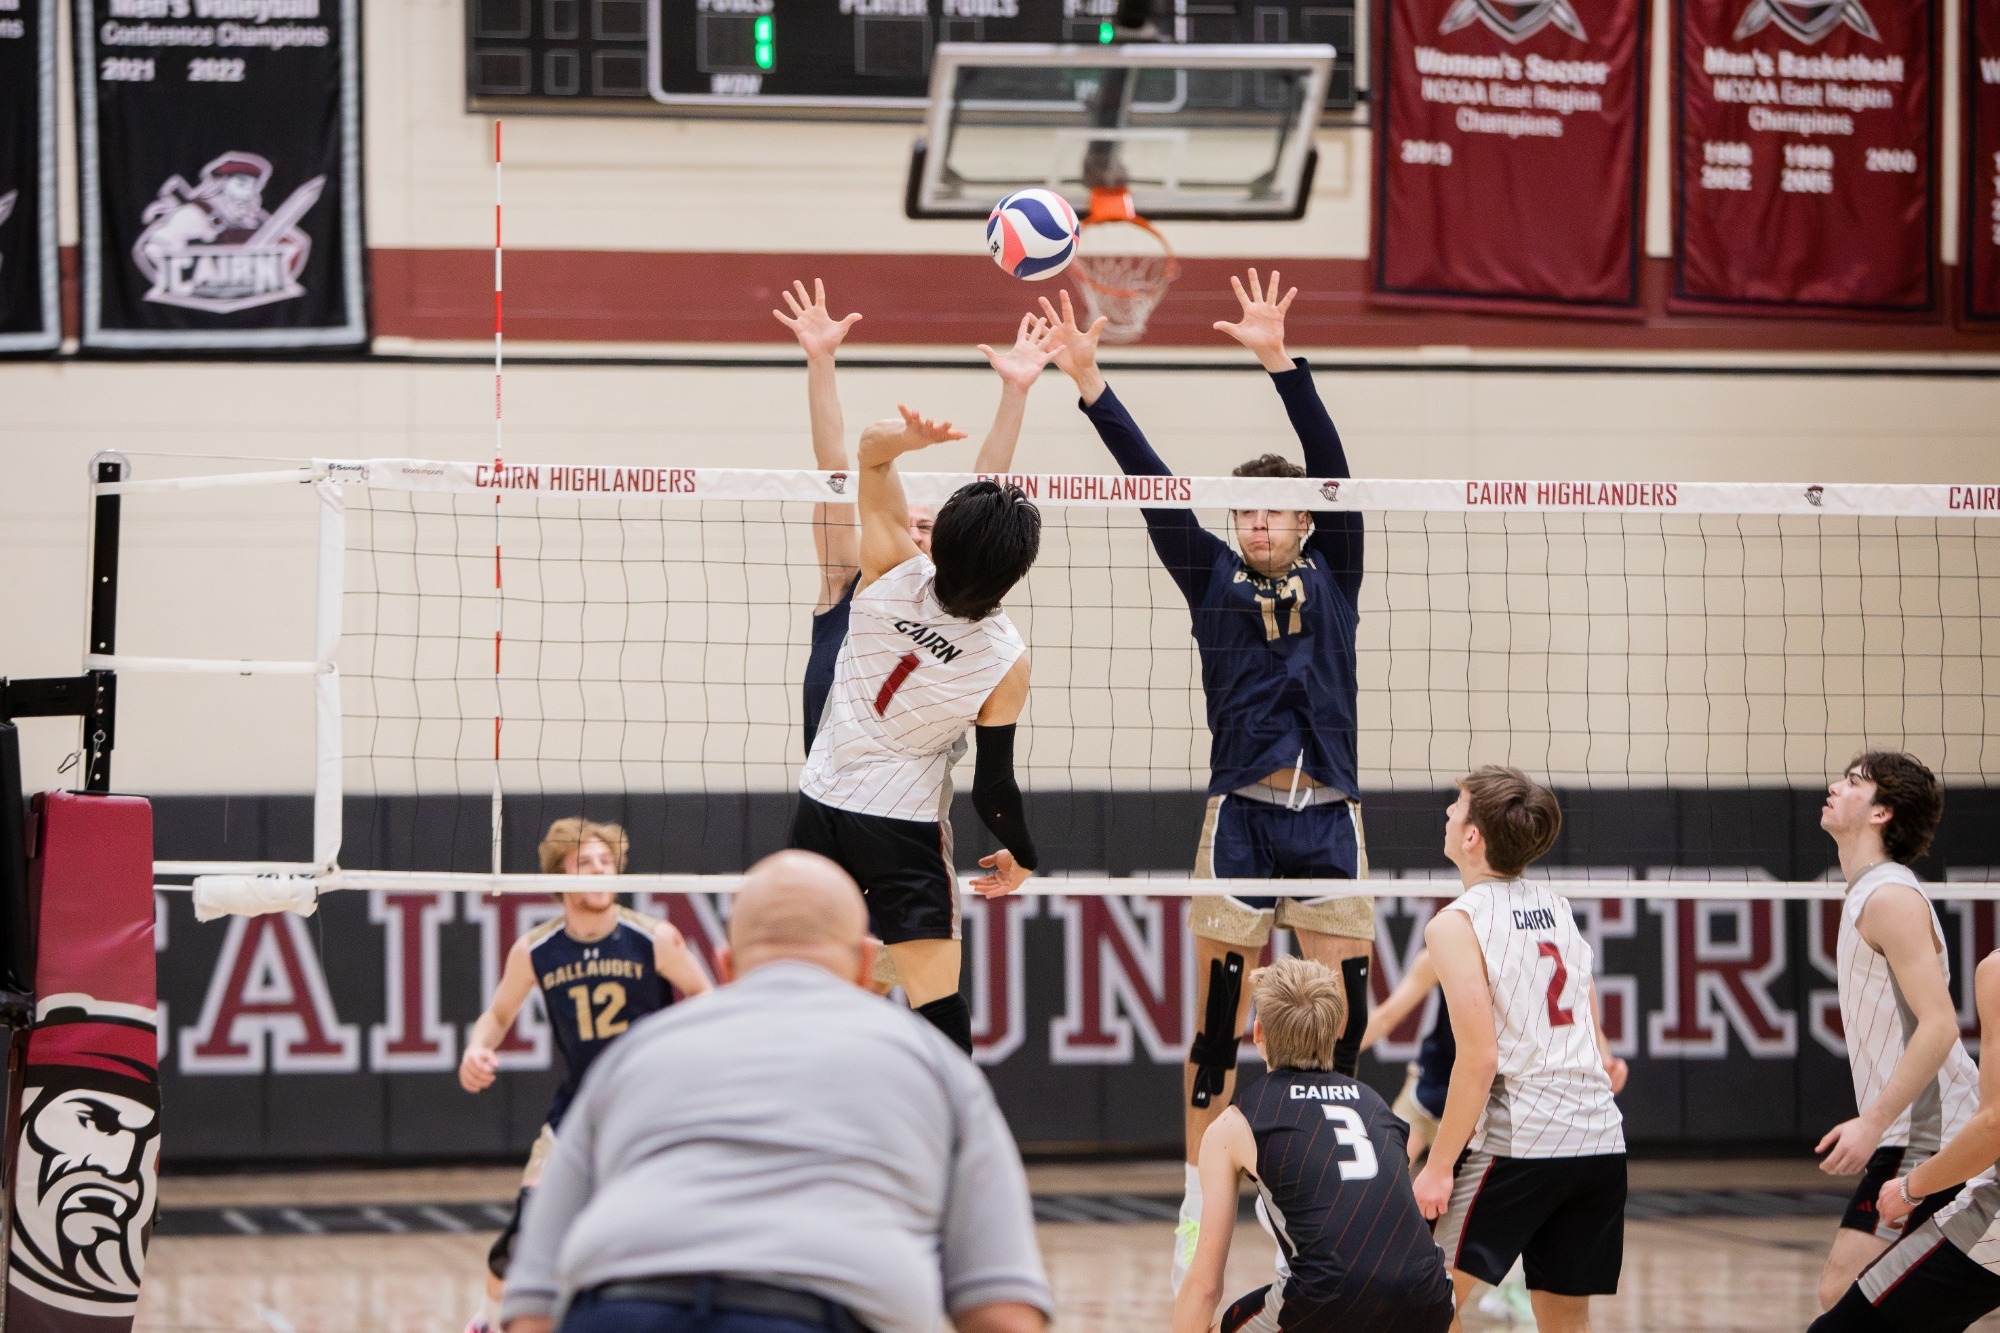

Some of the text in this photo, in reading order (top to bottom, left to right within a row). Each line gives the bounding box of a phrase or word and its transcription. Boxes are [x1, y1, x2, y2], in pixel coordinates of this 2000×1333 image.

[100, 19, 330, 50] Conference Champions
[1414, 45, 1611, 85] Women's Soccer
[1703, 46, 1905, 83] Men's Basketball
[1421, 77, 1602, 115] NCCAA East Region
[1714, 78, 1893, 113] NCCAA East Region
[1455, 106, 1563, 139] Champions
[1748, 105, 1854, 138] Champions
[170, 255, 279, 297] CAIRN
[475, 465, 697, 493] CAIRN HIGHLANDERS
[1048, 475, 1192, 502] HIGHLANDERS
[1466, 482, 1678, 507] CAIRN HIGHLANDERS
[1949, 486, 2000, 510] CAIR
[1254, 575, 1306, 641] 17
[894, 621, 963, 664] CAIRN
[873, 652, 922, 718] 1
[1512, 908, 1556, 930] CAIRN
[1537, 941, 1576, 1027] 2
[567, 981, 629, 1041] 12
[1290, 1084, 1361, 1100] CAIRN
[1321, 1103, 1379, 1181] 3
